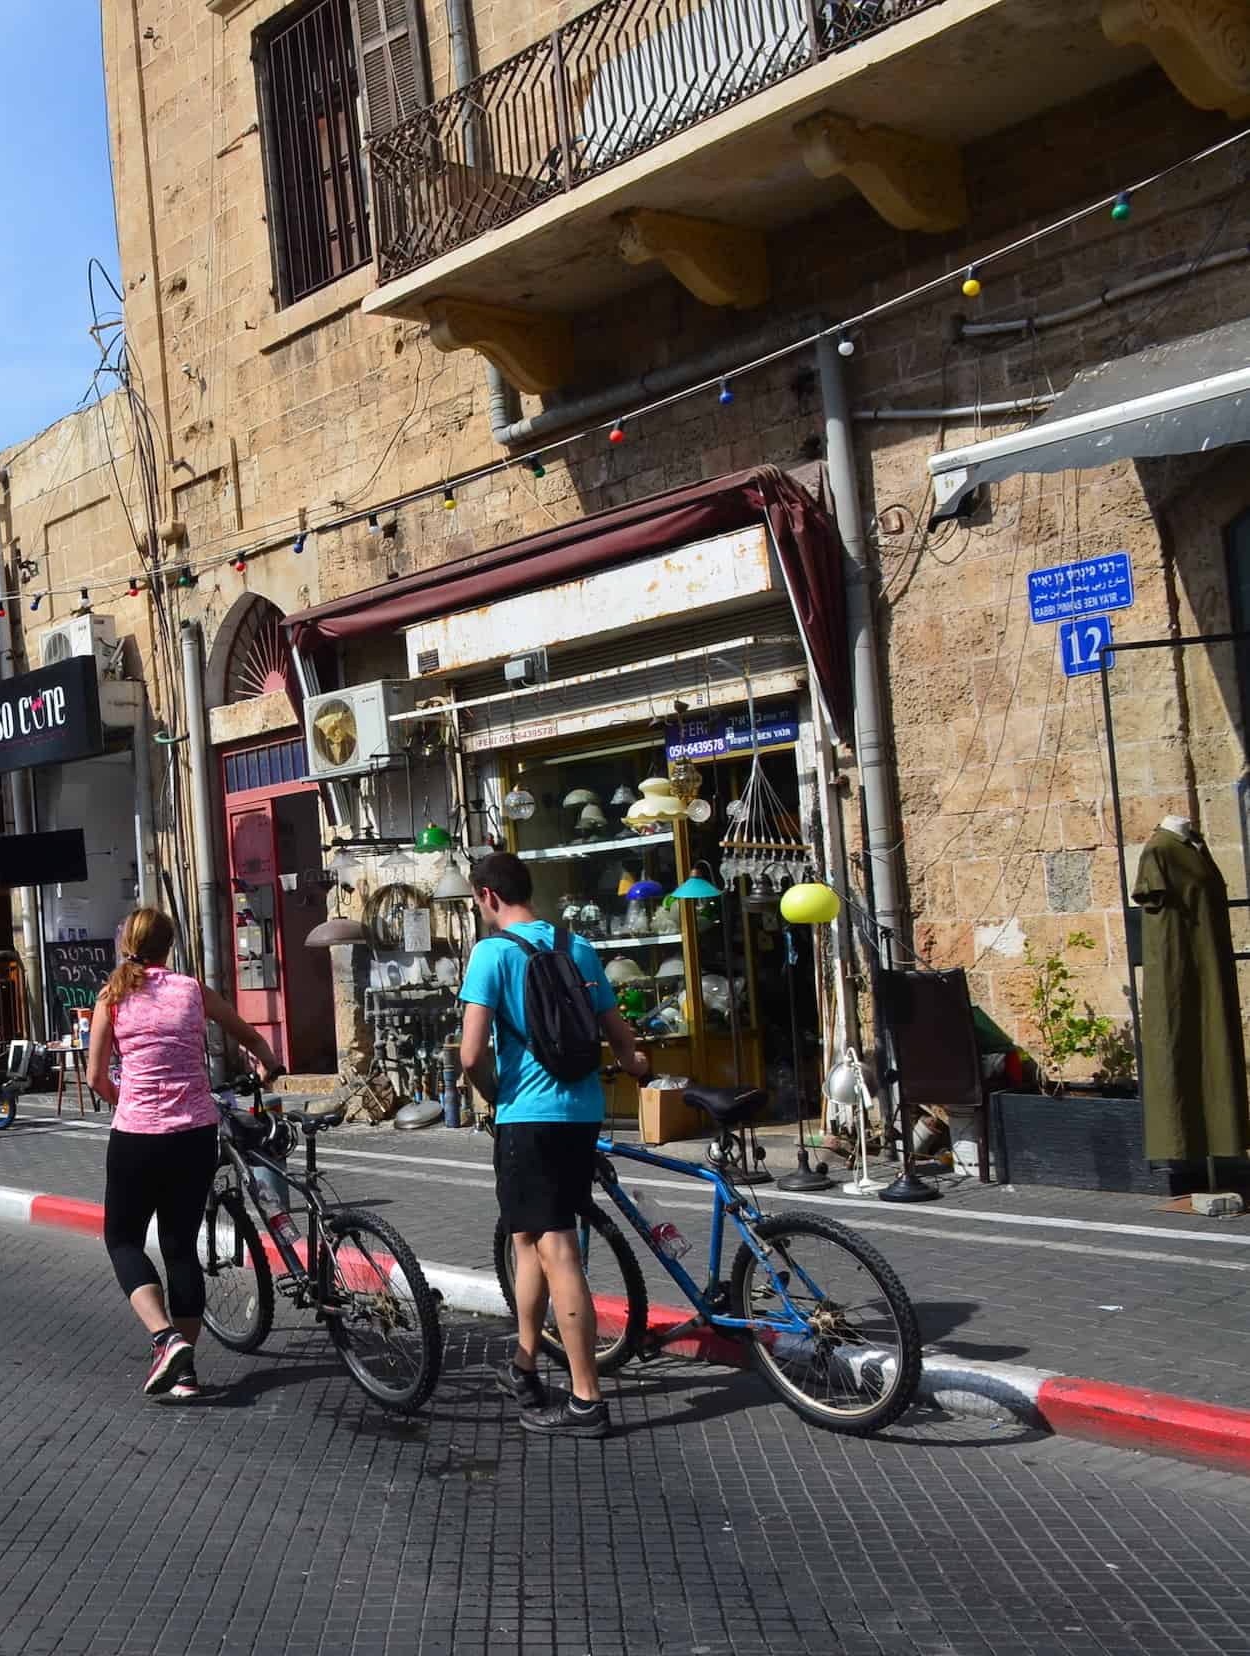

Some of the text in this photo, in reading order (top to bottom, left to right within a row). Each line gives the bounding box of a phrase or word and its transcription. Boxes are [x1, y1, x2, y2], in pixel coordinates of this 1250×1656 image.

[1084, 596, 1099, 607] BEN
[1066, 626, 1103, 666] 12
[669, 738, 724, 757] 050-6439578
